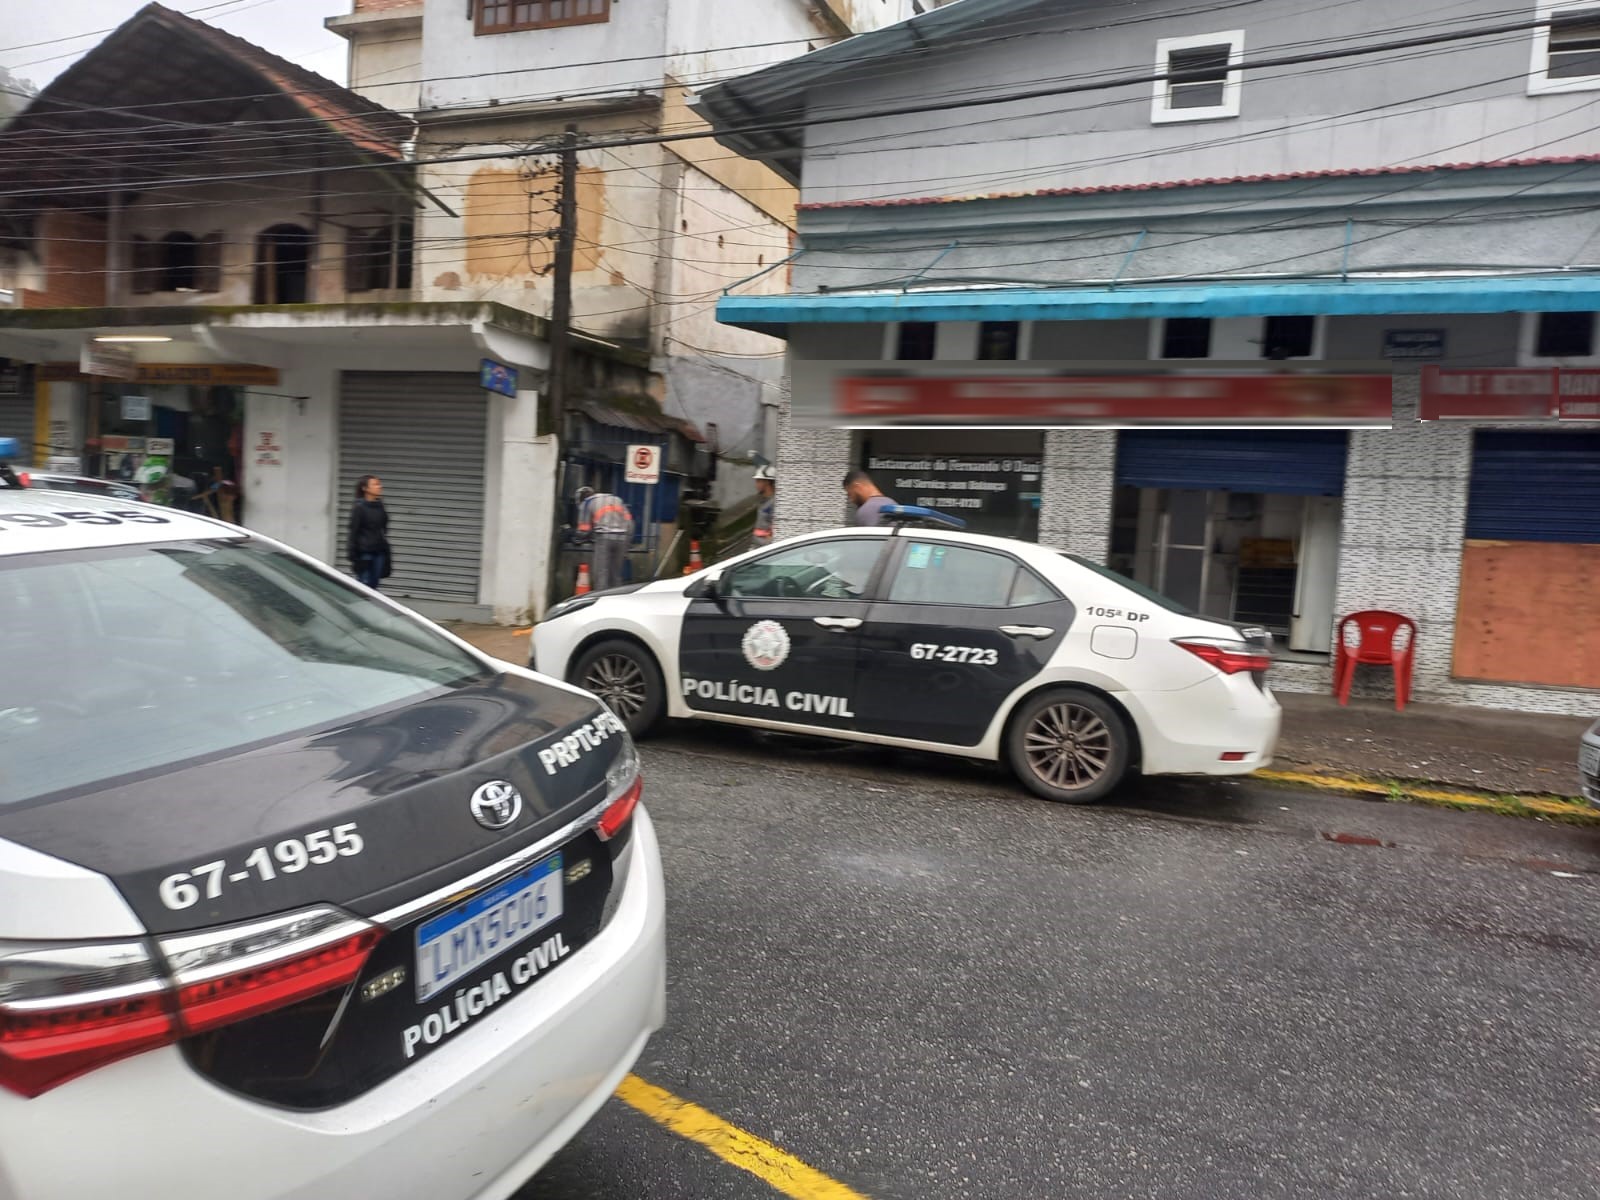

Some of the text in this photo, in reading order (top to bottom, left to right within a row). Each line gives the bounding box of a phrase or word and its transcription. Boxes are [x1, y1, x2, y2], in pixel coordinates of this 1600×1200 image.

[868, 457, 932, 470] Restaurante
[948, 459, 1000, 472] Fernando
[0, 511, 171, 531] 955
[1127, 611, 1150, 622] DP
[910, 643, 999, 665] 67-2723
[682, 678, 855, 718] POLÍCIA CIVIL
[159, 822, 364, 910] 67-1955
[432, 882, 549, 982] LMX5C06
[402, 932, 571, 1058] POLÍCIA CIVIL
